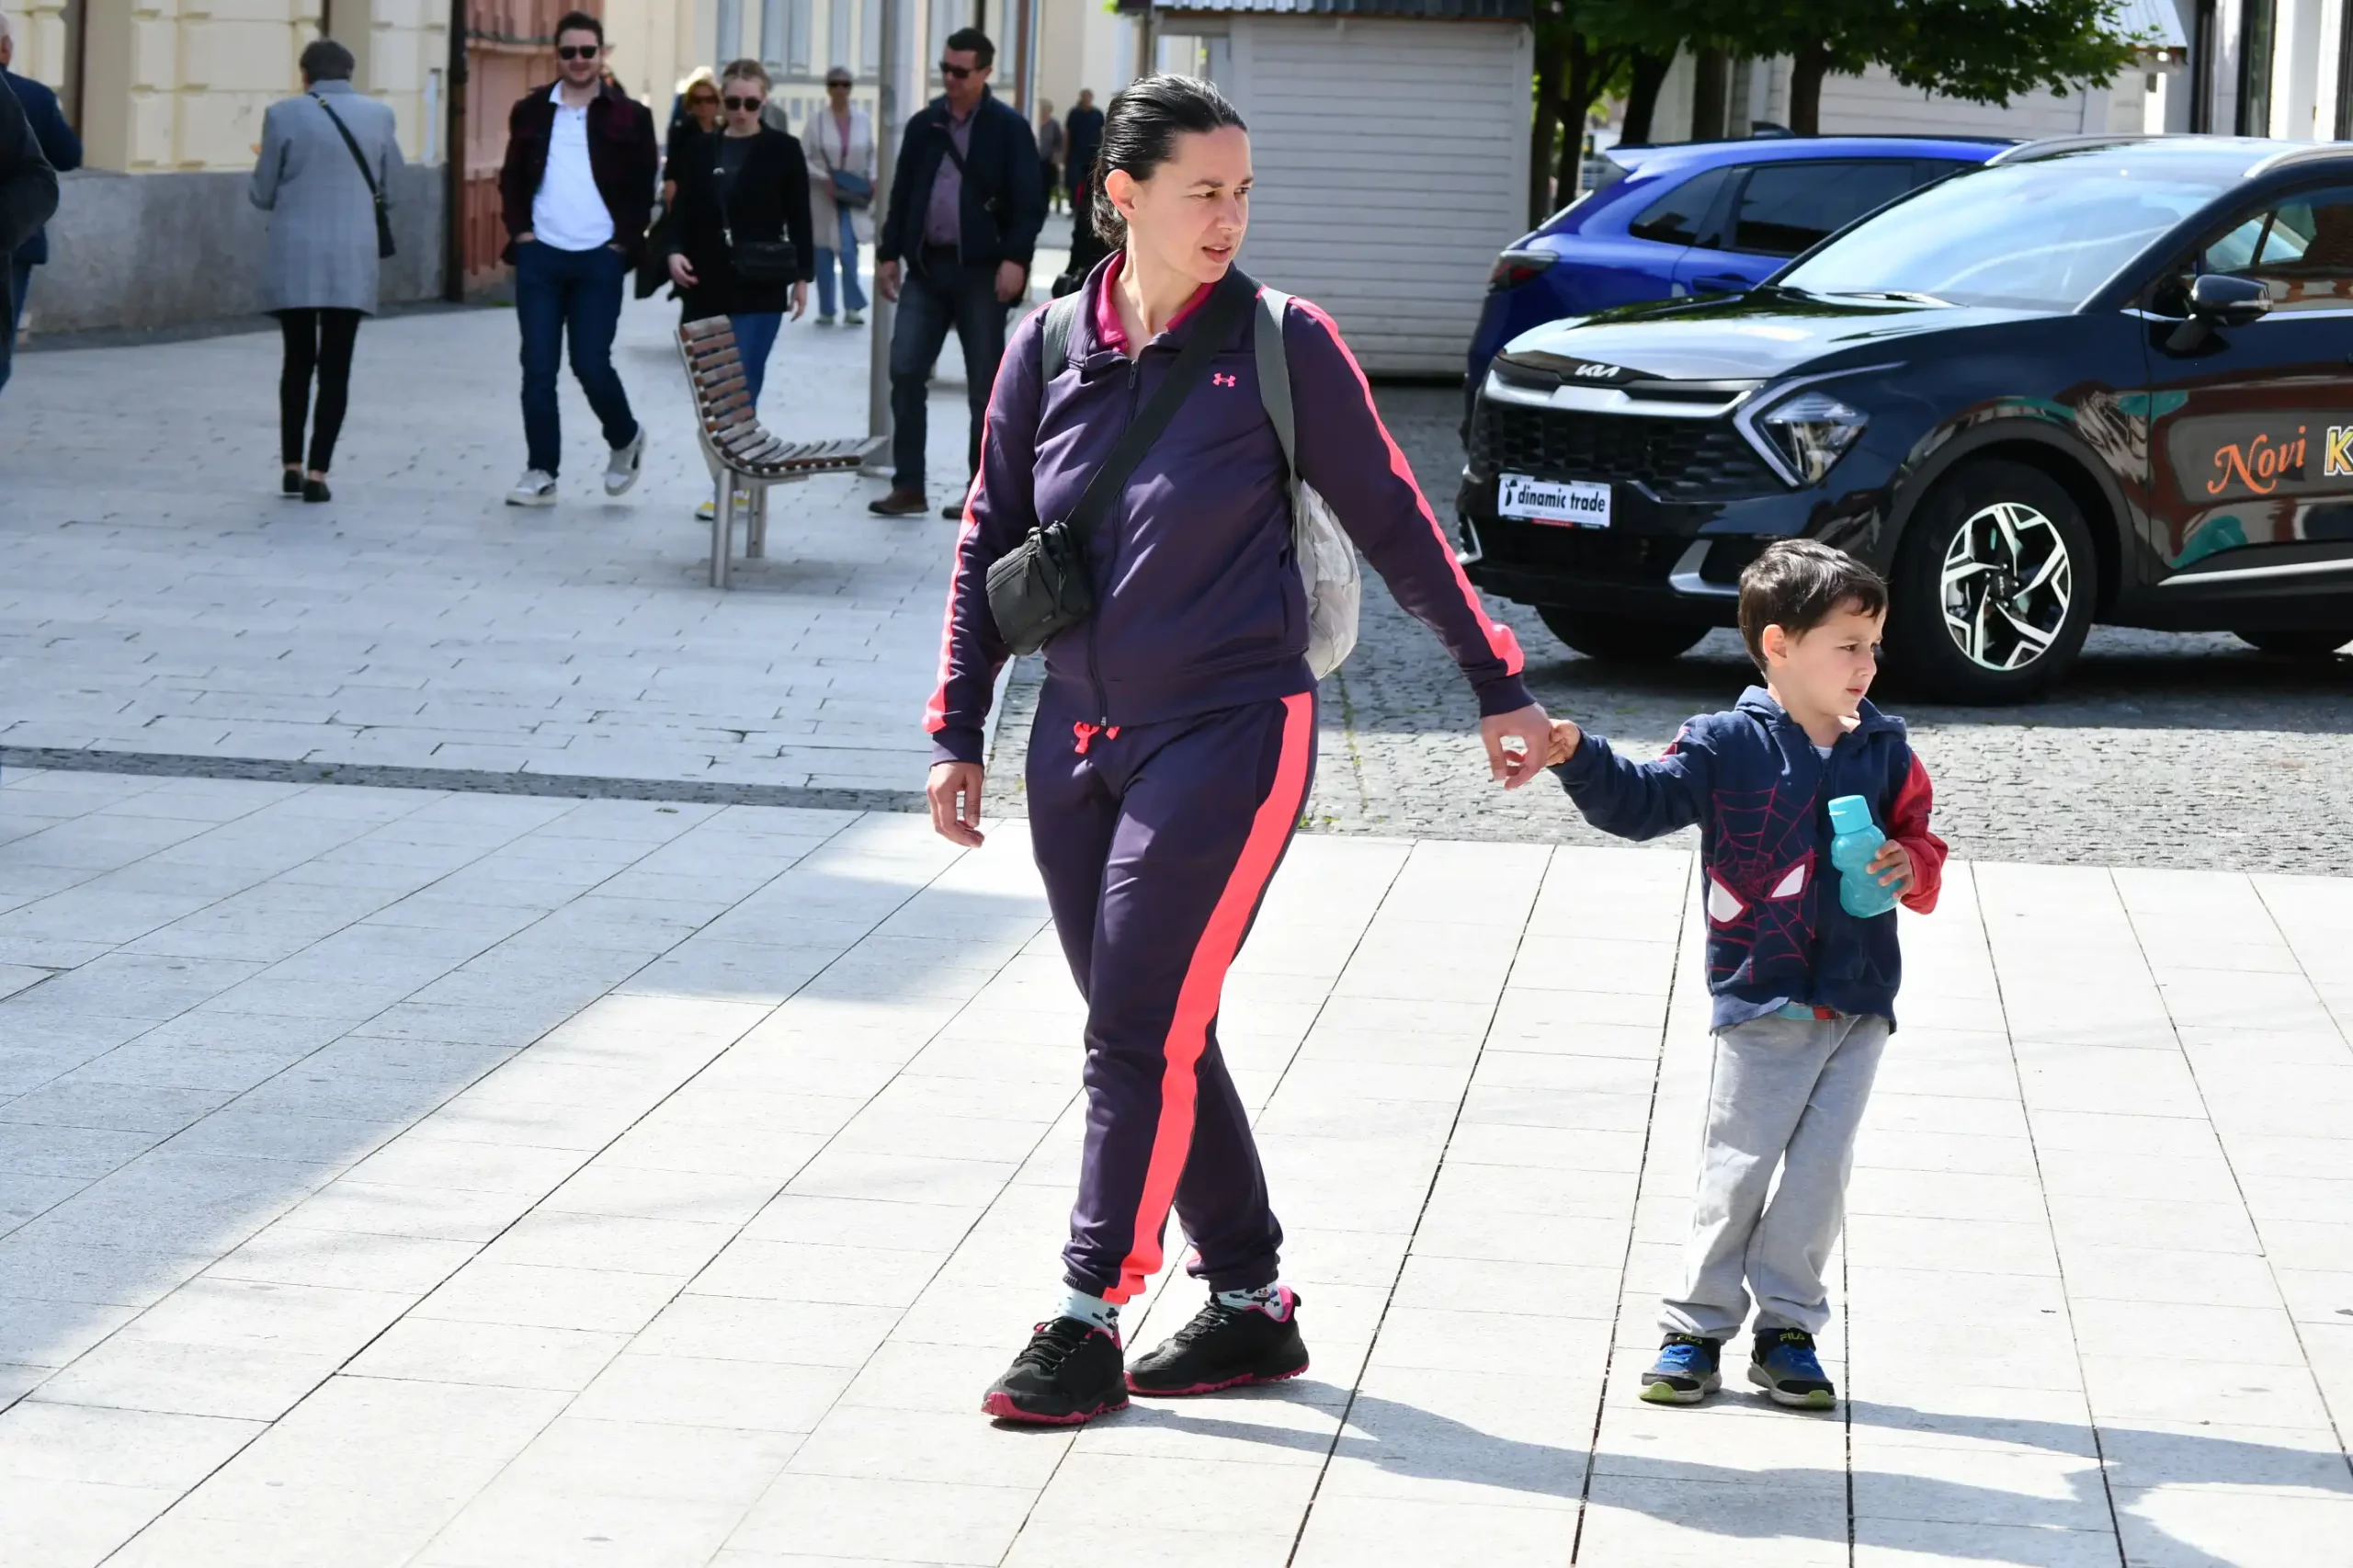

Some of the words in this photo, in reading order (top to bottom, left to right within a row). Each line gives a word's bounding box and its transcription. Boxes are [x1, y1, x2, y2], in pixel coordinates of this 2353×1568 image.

[2207, 426, 2306, 494] Novi
[1518, 483, 1566, 508] dinamic
[1570, 491, 1606, 513] trade
[1779, 1332, 1806, 1342] FILA
